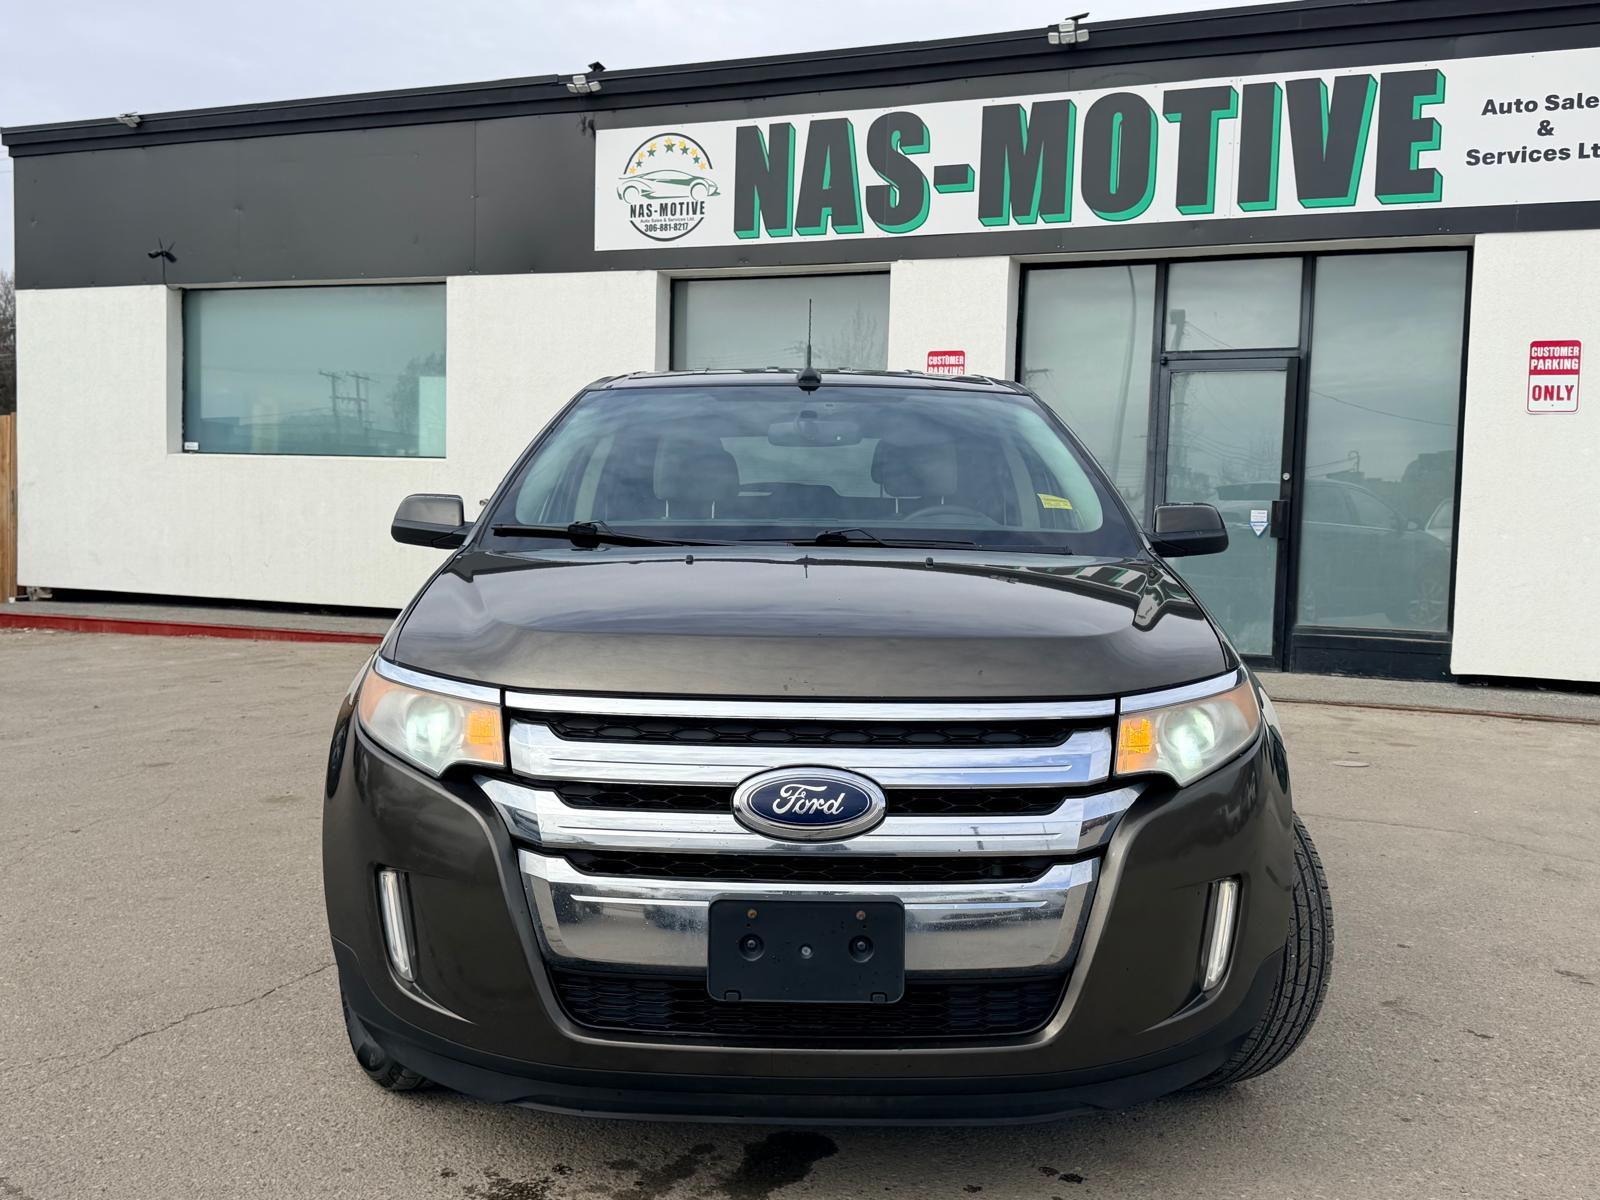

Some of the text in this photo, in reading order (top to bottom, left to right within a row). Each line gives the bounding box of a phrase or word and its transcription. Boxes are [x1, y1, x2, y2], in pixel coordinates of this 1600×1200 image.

[1481, 98, 1538, 116] Auto
[1537, 119, 1555, 136] &
[733, 68, 1446, 240] NAS-MOTIVE
[1465, 145, 1571, 166] Services
[630, 200, 705, 218] NAS-MOTIVE
[644, 222, 689, 233] 306-881-8217
[928, 355, 964, 365] CUSTOMER
[1531, 346, 1580, 357] CUSTOMER
[1530, 358, 1579, 370] PARKING
[1532, 384, 1575, 401] ONLY
[772, 783, 846, 815] Ford
